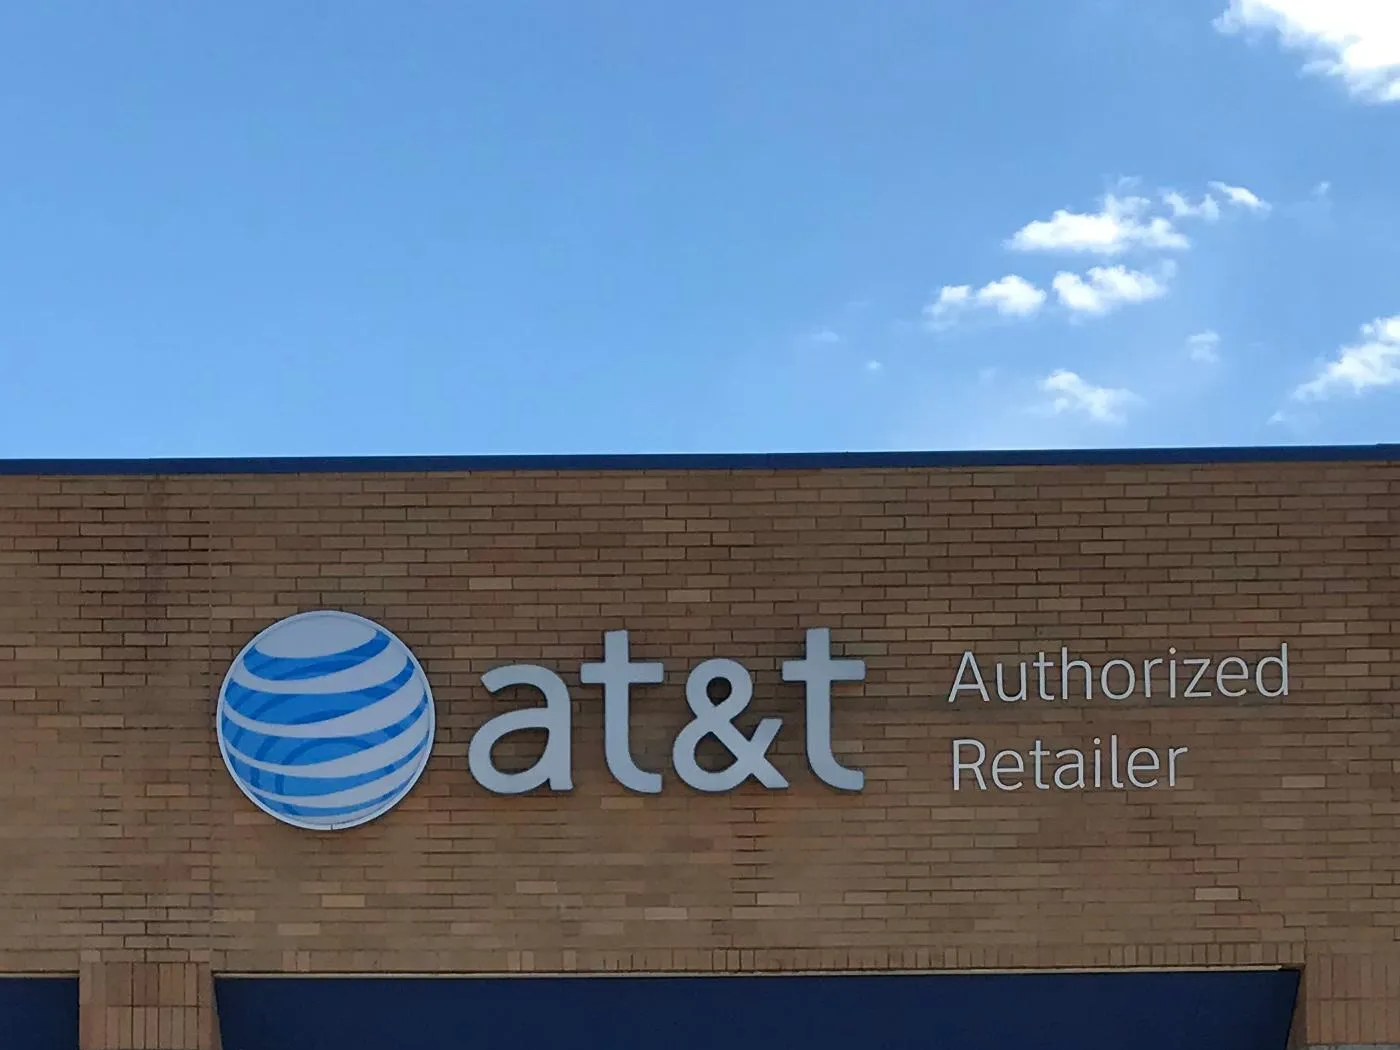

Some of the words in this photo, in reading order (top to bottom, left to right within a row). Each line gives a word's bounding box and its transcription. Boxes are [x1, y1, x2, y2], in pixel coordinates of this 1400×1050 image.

[947, 642, 1290, 703] Authorized
[467, 626, 867, 795] at&t
[952, 734, 1189, 791] Retailer
